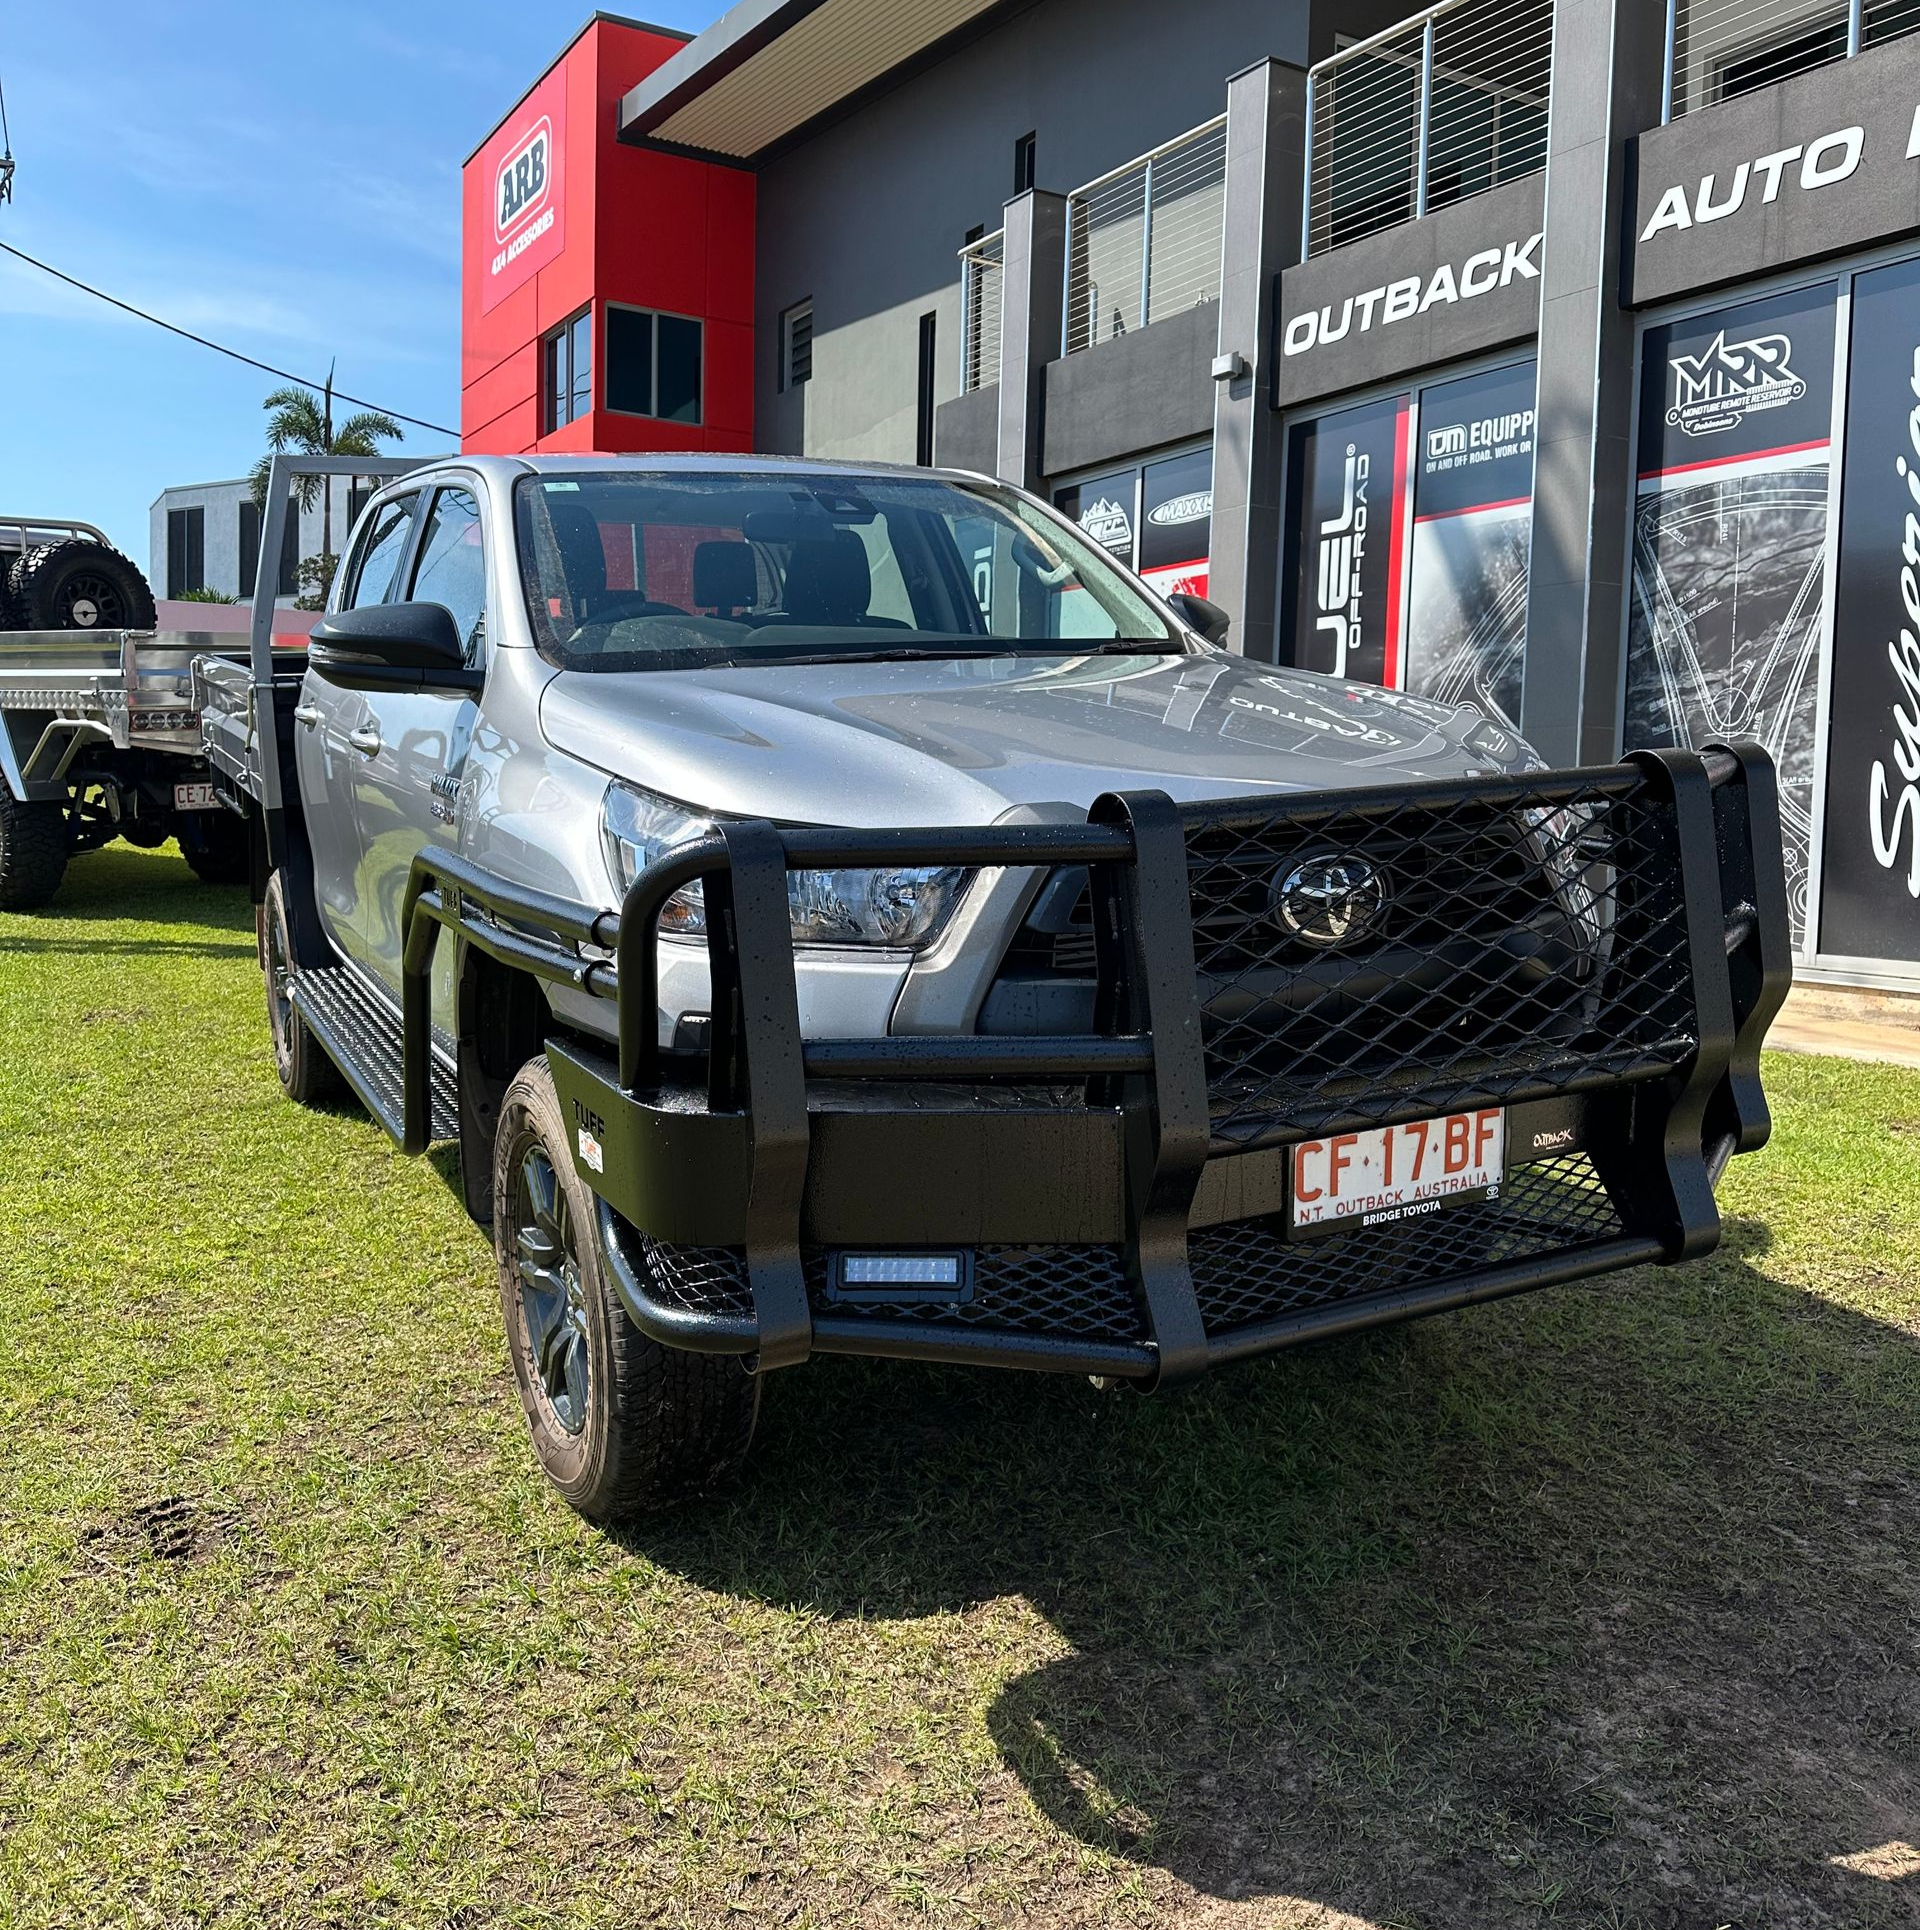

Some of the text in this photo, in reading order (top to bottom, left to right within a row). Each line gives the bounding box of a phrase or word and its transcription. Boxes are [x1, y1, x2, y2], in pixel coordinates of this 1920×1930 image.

[501, 139, 545, 225] ARB
[1639, 126, 1865, 242] AUTO
[507, 206, 554, 265] ACCESSORIES
[1284, 232, 1544, 356] OUTBACK
[1669, 330, 1801, 406] MRR
[1682, 386, 1793, 418] MONOTUBE REMOTE RESERVOIR
[1470, 409, 1535, 447] EQUIPP
[1426, 462, 1436, 473] ON
[1438, 458, 1452, 471] AND
[1454, 455, 1467, 467] OFF
[1495, 443, 1518, 458] WORK
[1520, 440, 1531, 453] OR
[1349, 454, 1369, 648] OFF-ROAD
[573, 1098, 605, 1138] TUFF
[1336, 1190, 1403, 1216] OUTBACK
[1414, 1172, 1489, 1199] AUSTRALIA
[1363, 1201, 1441, 1226] BRIDGE TOYOTA
